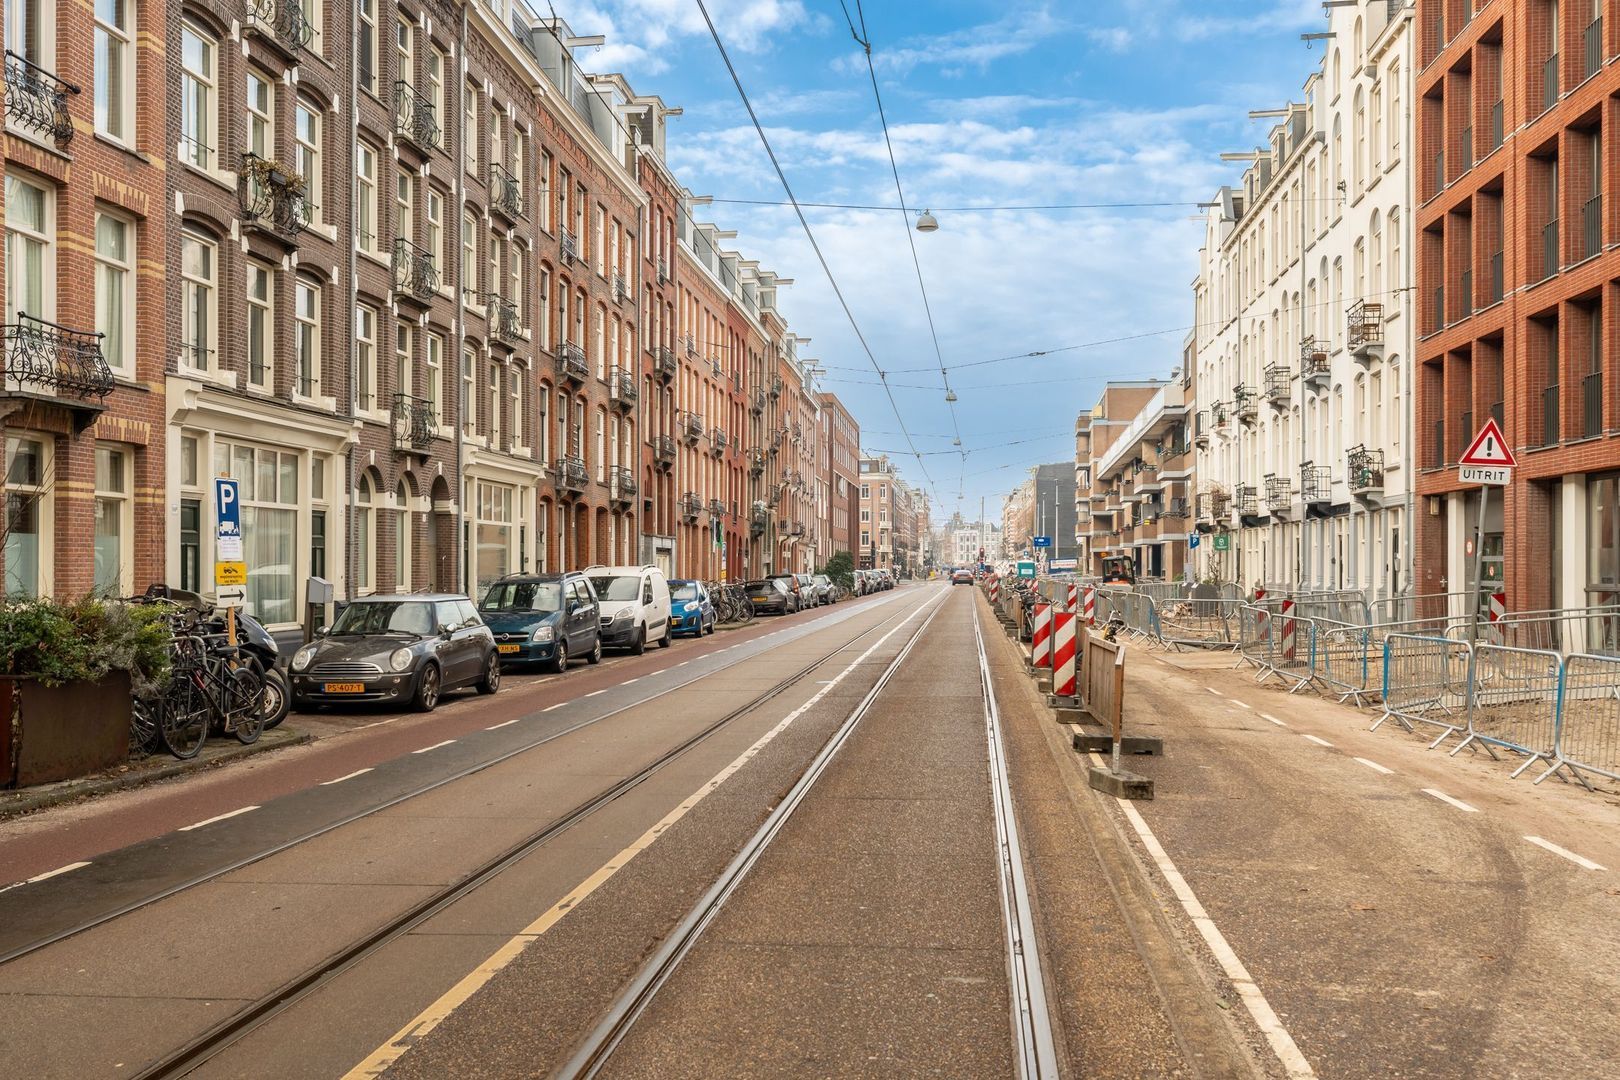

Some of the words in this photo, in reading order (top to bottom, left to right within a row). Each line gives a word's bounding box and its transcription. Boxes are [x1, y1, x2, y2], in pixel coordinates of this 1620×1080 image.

[1463, 469, 1505, 480] UITRIT
[220, 484, 234, 513] P
[327, 684, 361, 692] PS-407-T
